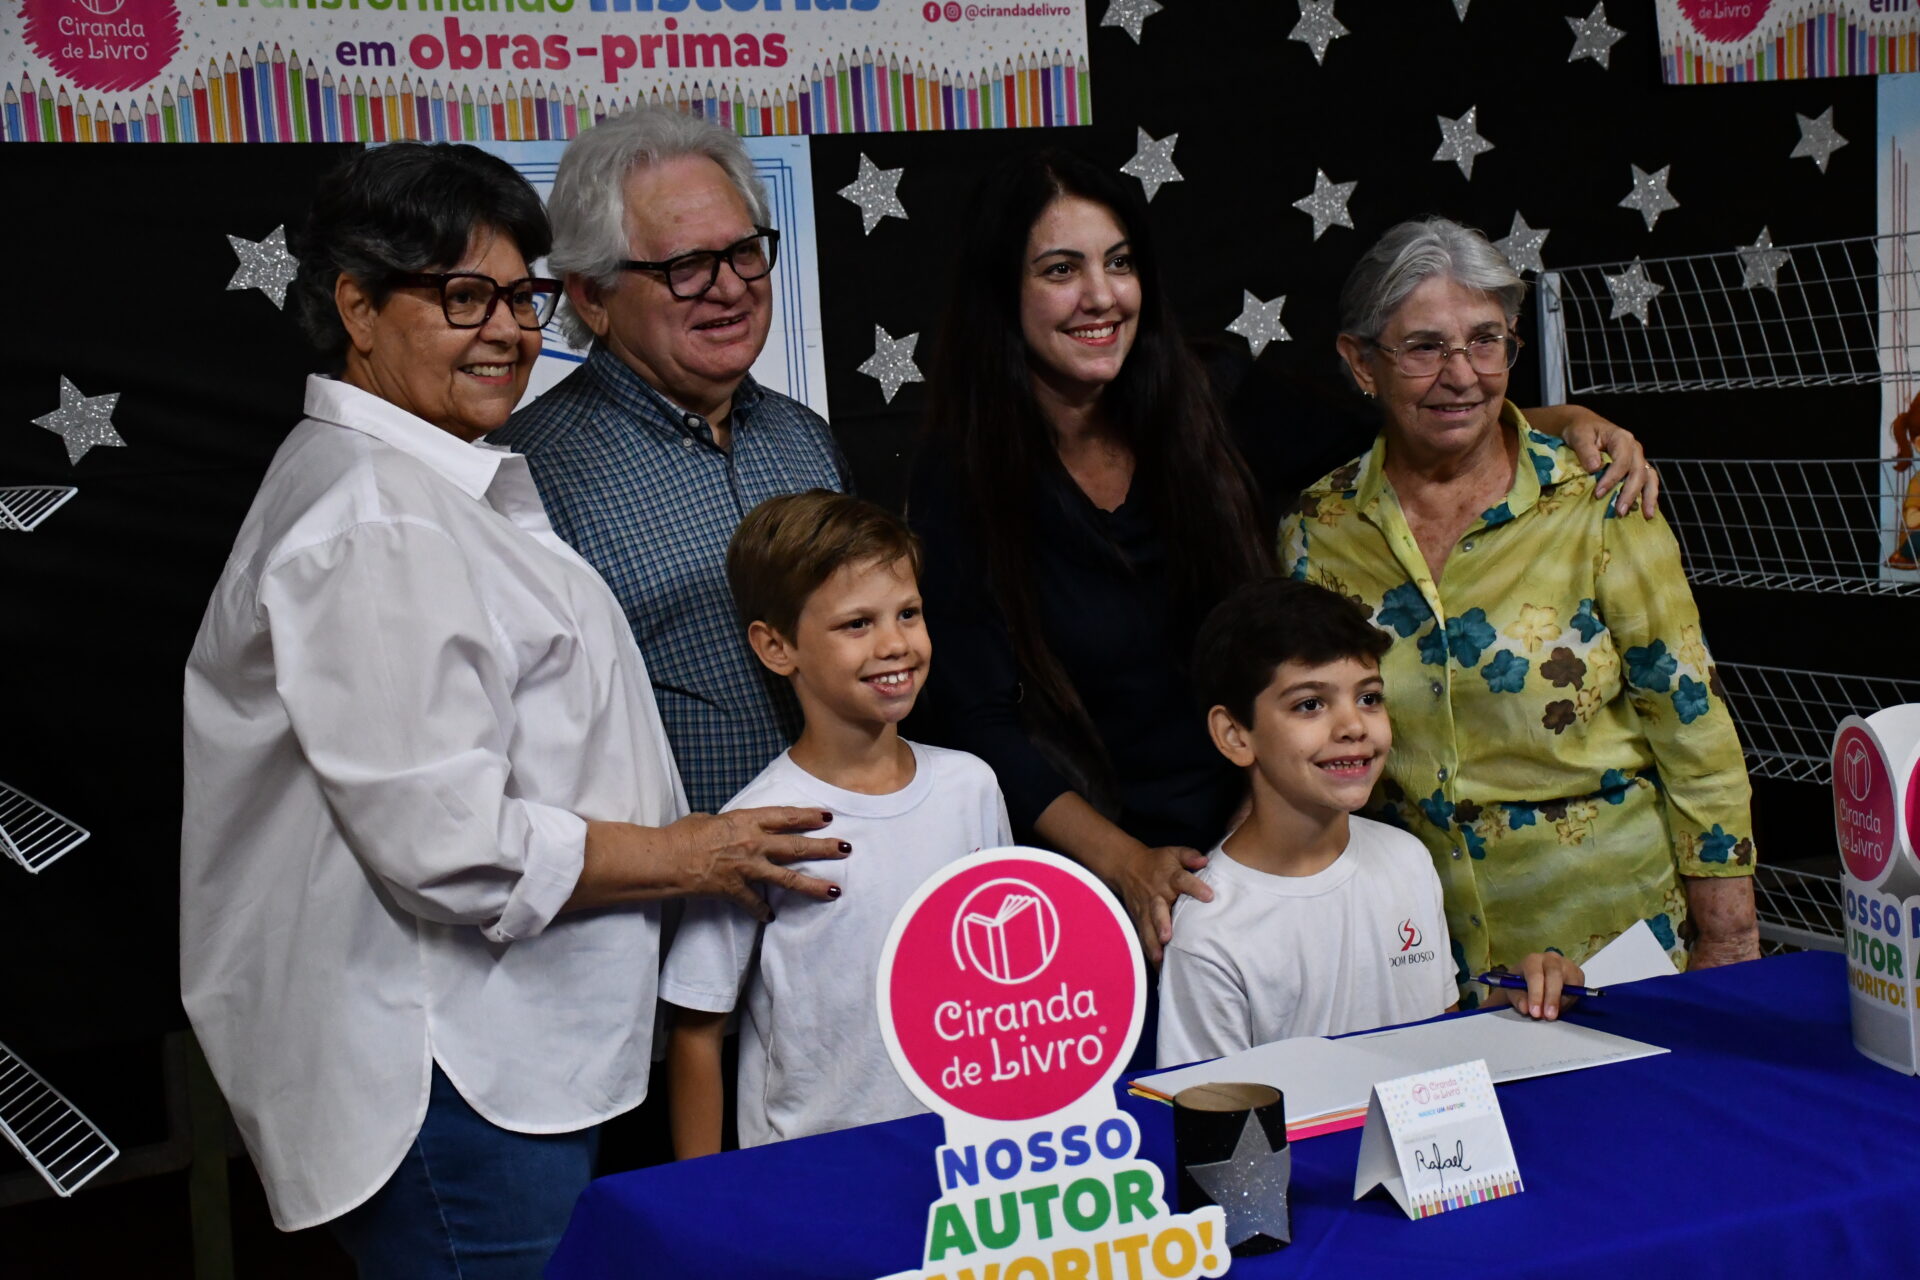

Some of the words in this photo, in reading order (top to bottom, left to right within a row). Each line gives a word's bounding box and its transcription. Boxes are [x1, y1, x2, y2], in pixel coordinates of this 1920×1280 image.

[58, 16, 145, 38] Ciranda
[964, 4, 1071, 21] @cirandadelivro
[1714, 1, 1751, 18] Livro
[61, 43, 84, 59] de
[88, 38, 148, 60] Livro
[335, 41, 396, 67] em
[408, 17, 789, 84] obras-primas
[1840, 798, 1882, 835] Ciranda
[1850, 827, 1883, 862] Livro
[1408, 950, 1435, 965] BOSCO
[934, 982, 1098, 1041] Ciranda
[941, 1056, 983, 1089] de
[991, 1034, 1103, 1082] Livro
[942, 1118, 1132, 1190] NOSSO
[1414, 1139, 1472, 1193] Rafael
[929, 1169, 1158, 1262] AUTOR
